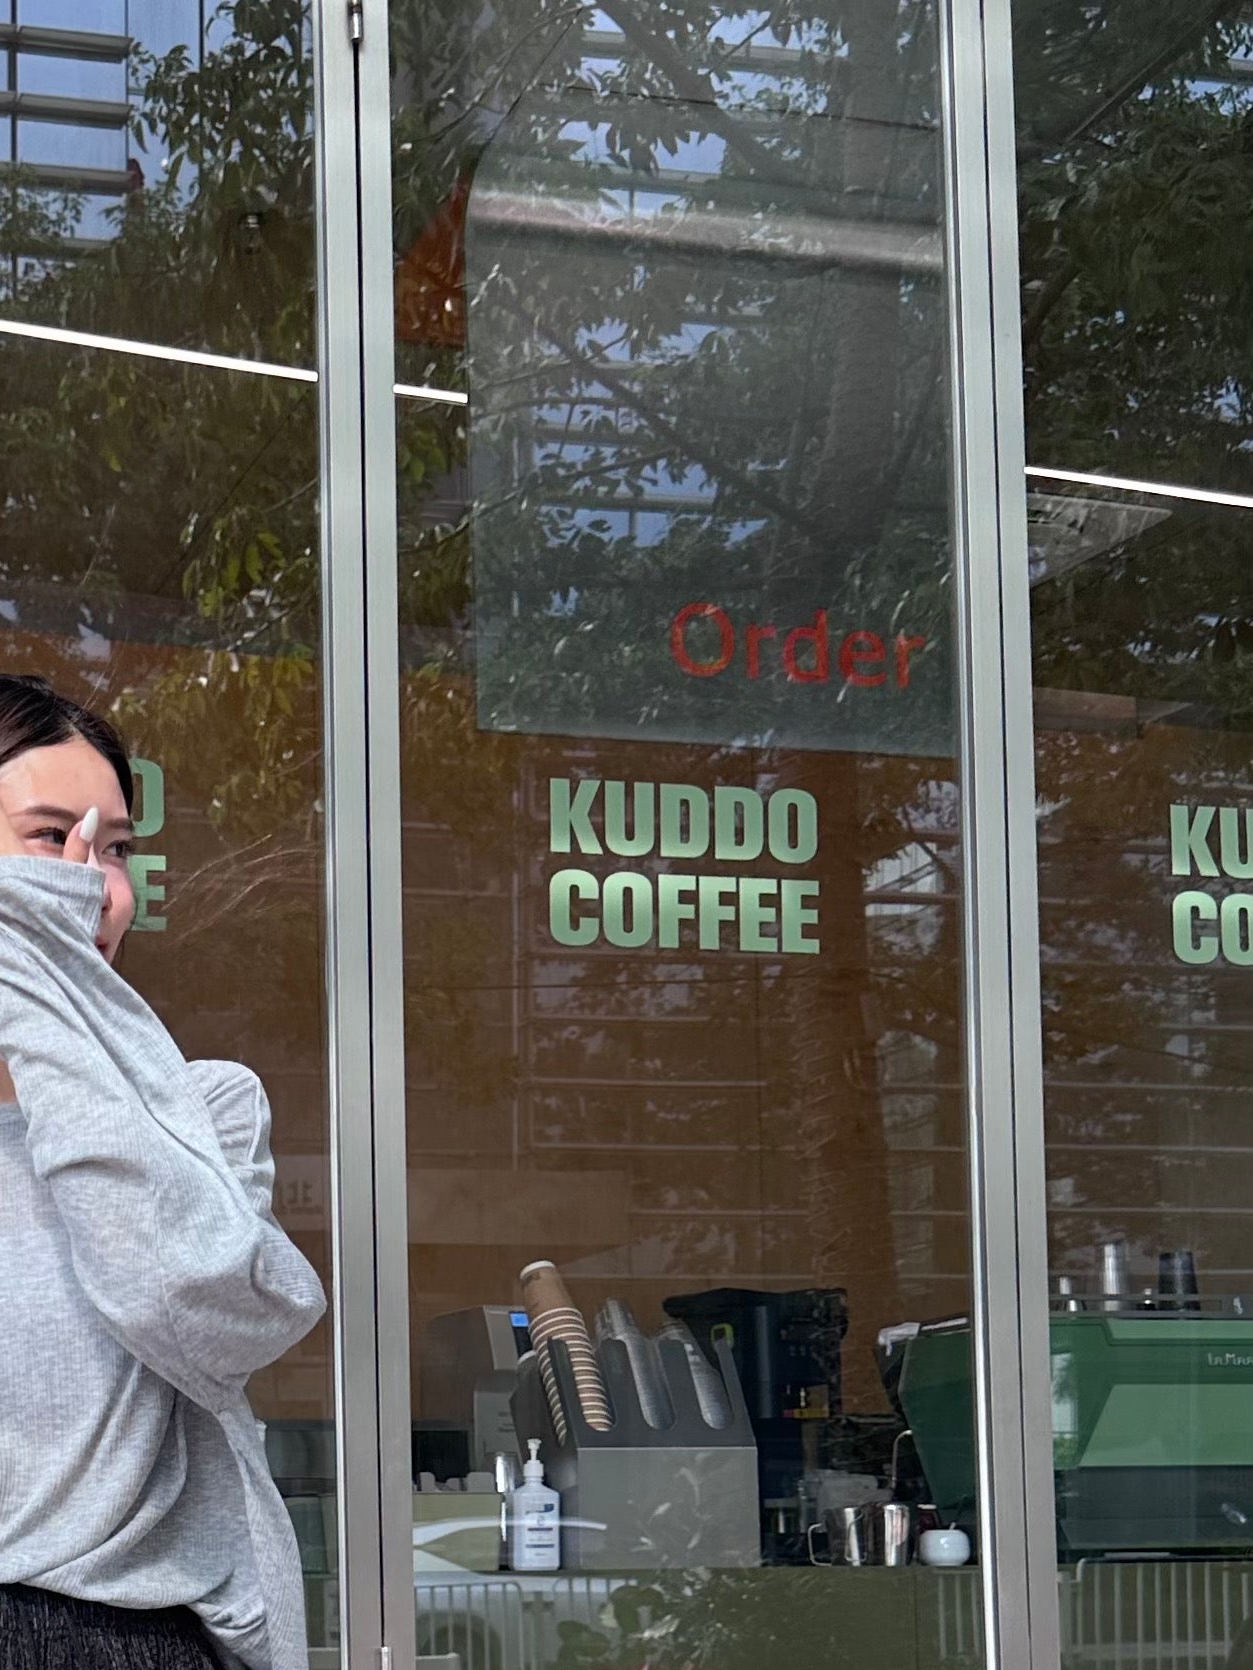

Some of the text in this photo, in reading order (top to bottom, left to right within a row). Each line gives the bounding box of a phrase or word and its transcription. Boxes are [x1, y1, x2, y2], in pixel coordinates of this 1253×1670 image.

[670, 601, 927, 688] Order
[549, 777, 819, 864] KUDDO
[549, 868, 821, 955] COFFEE
